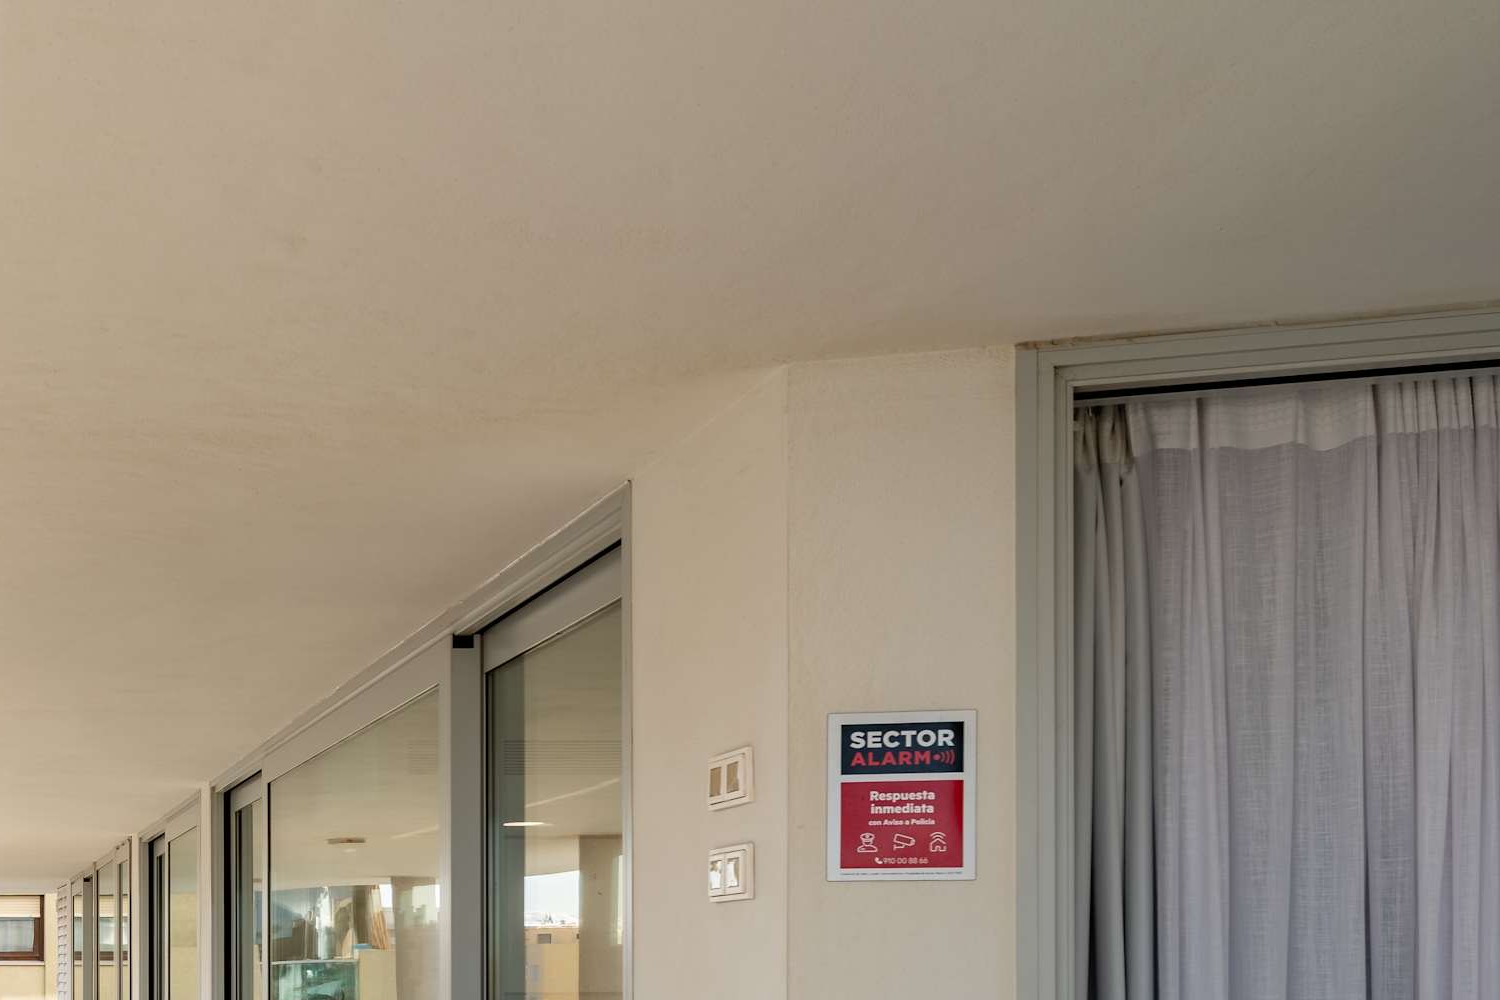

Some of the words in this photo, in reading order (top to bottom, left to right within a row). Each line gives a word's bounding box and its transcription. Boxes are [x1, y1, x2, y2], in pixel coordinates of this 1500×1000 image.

[850, 729, 955, 749] SECTOR
[851, 751, 931, 766] ALARM
[869, 790, 935, 803] Respuesta
[870, 803, 934, 814] inmediata
